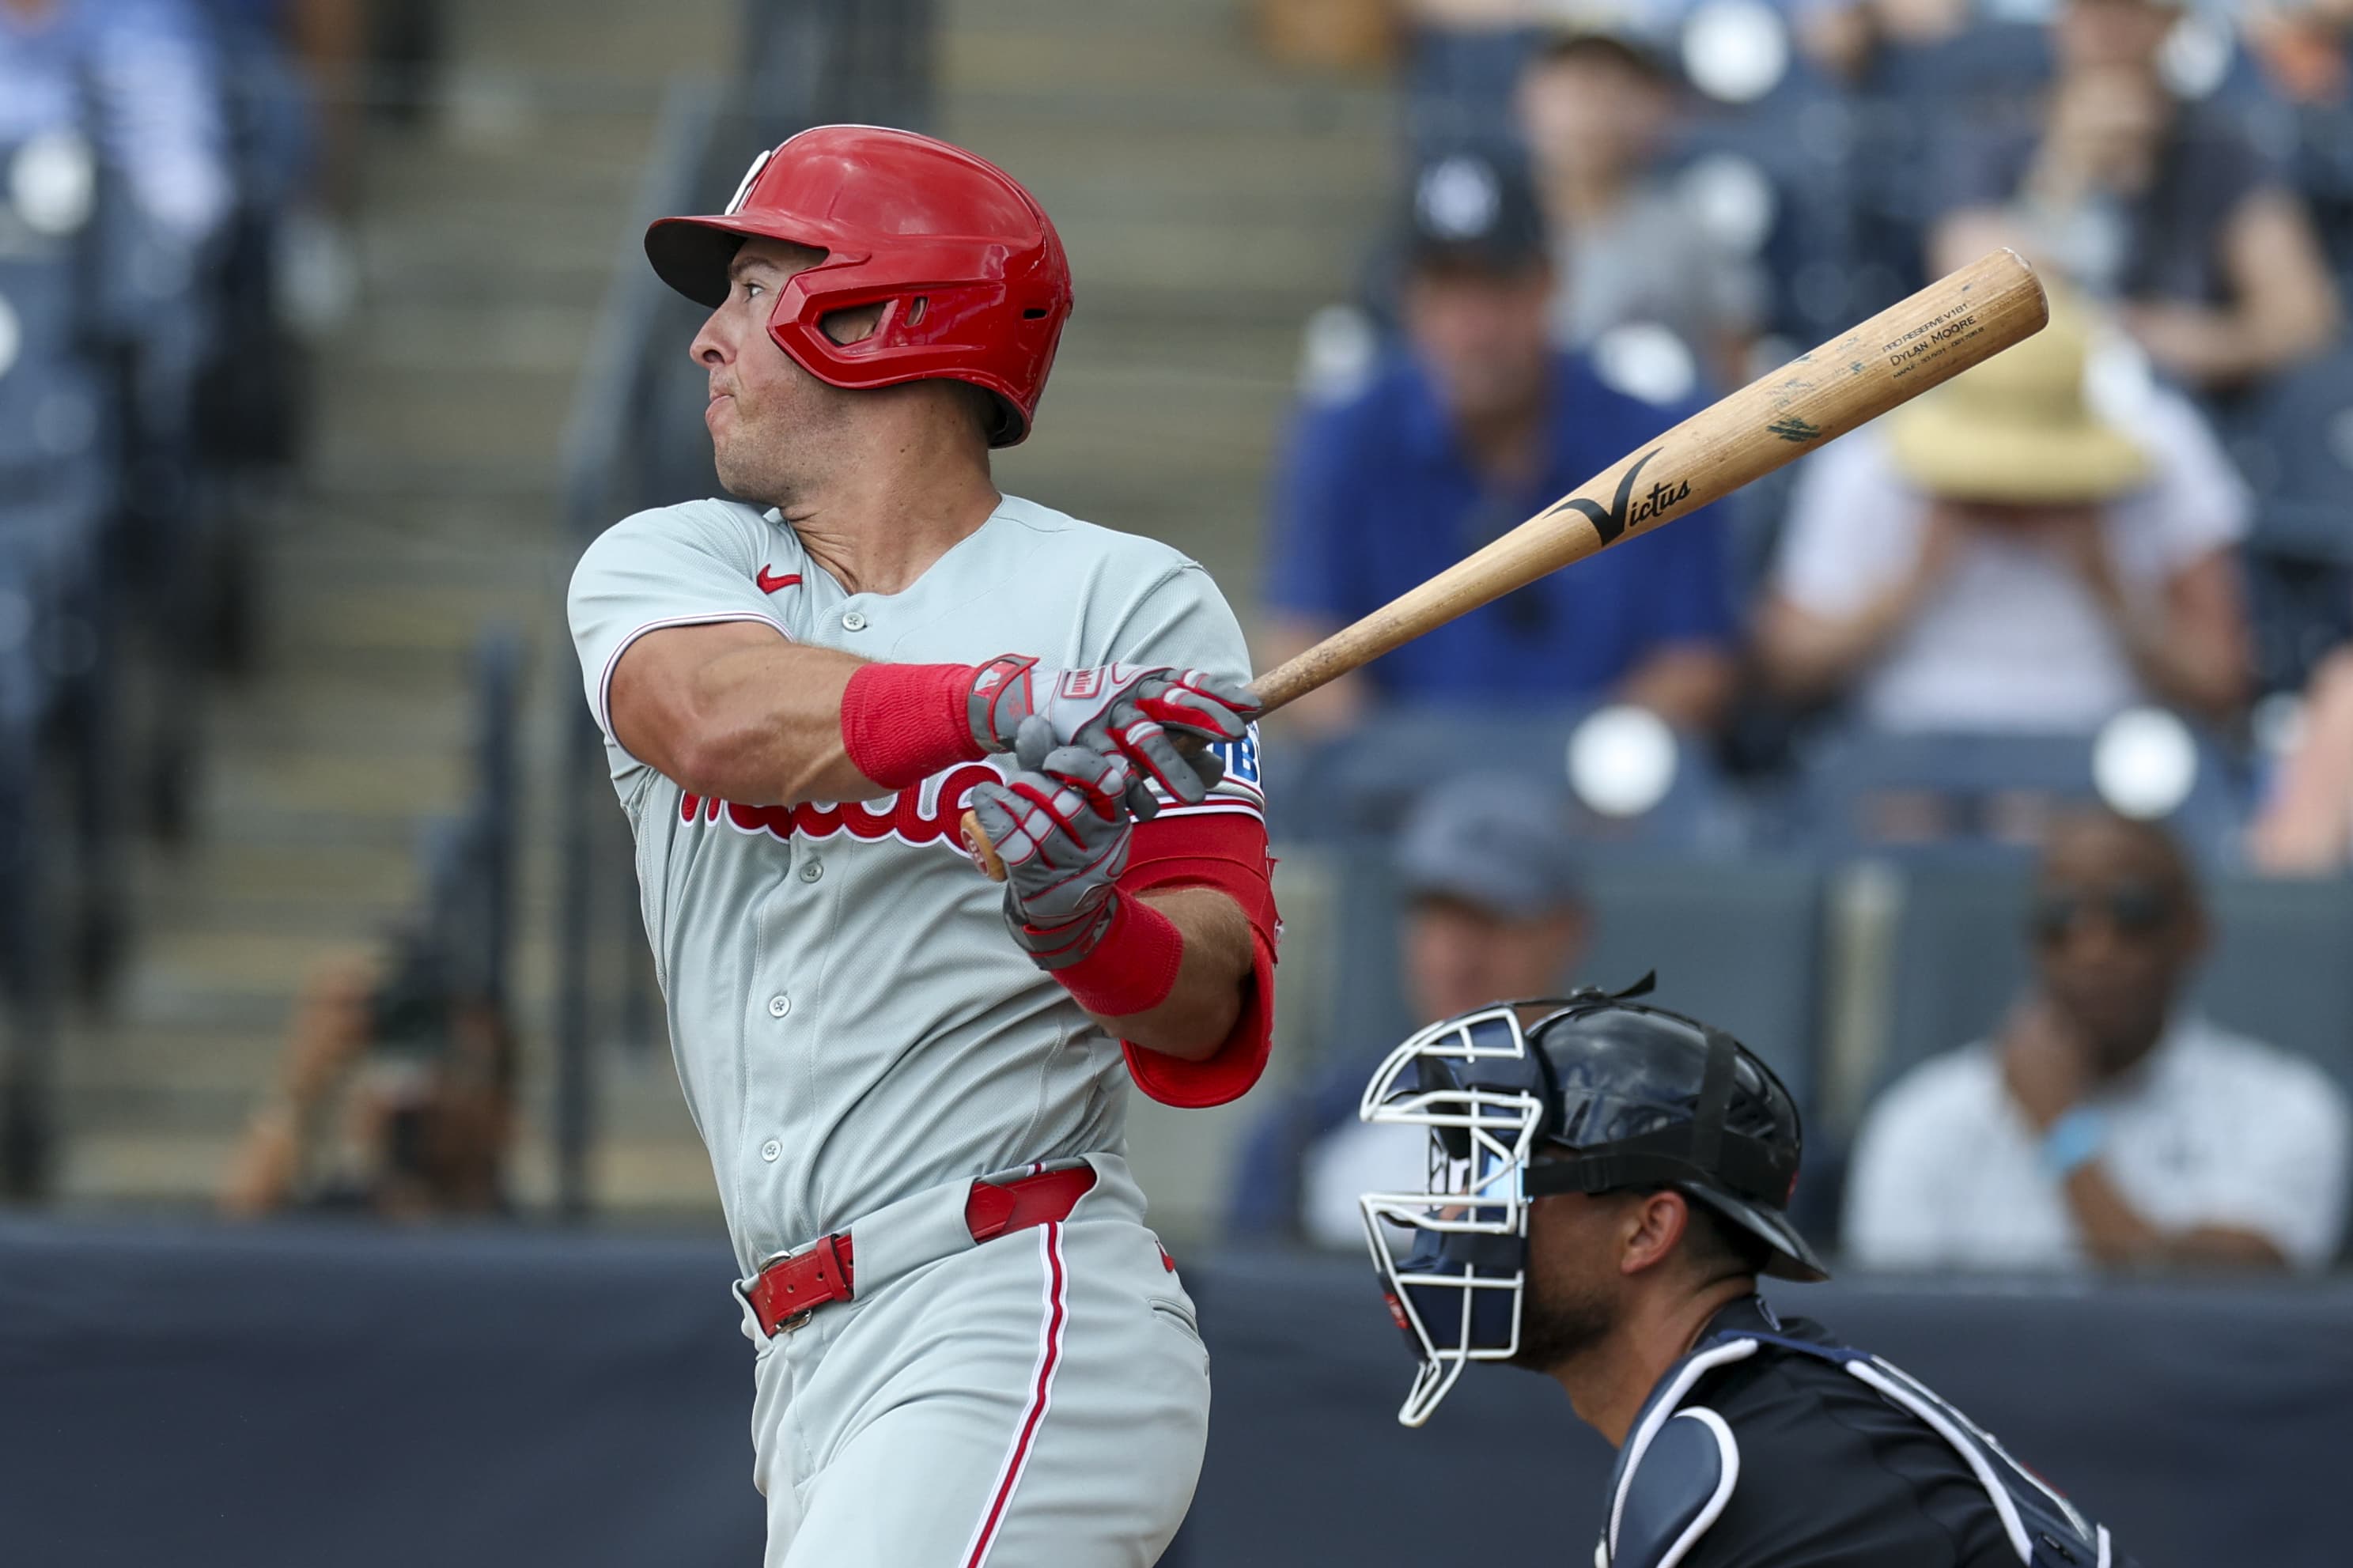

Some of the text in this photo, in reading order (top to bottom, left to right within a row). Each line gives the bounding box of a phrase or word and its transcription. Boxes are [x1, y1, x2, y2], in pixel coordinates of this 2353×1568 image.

[1882, 338, 1903, 353] PRO
[1902, 316, 1945, 342] RESERVE
[1890, 342, 1929, 366] DYLAN
[1931, 315, 1977, 344] MOORE
[1542, 446, 1692, 547] Victus
